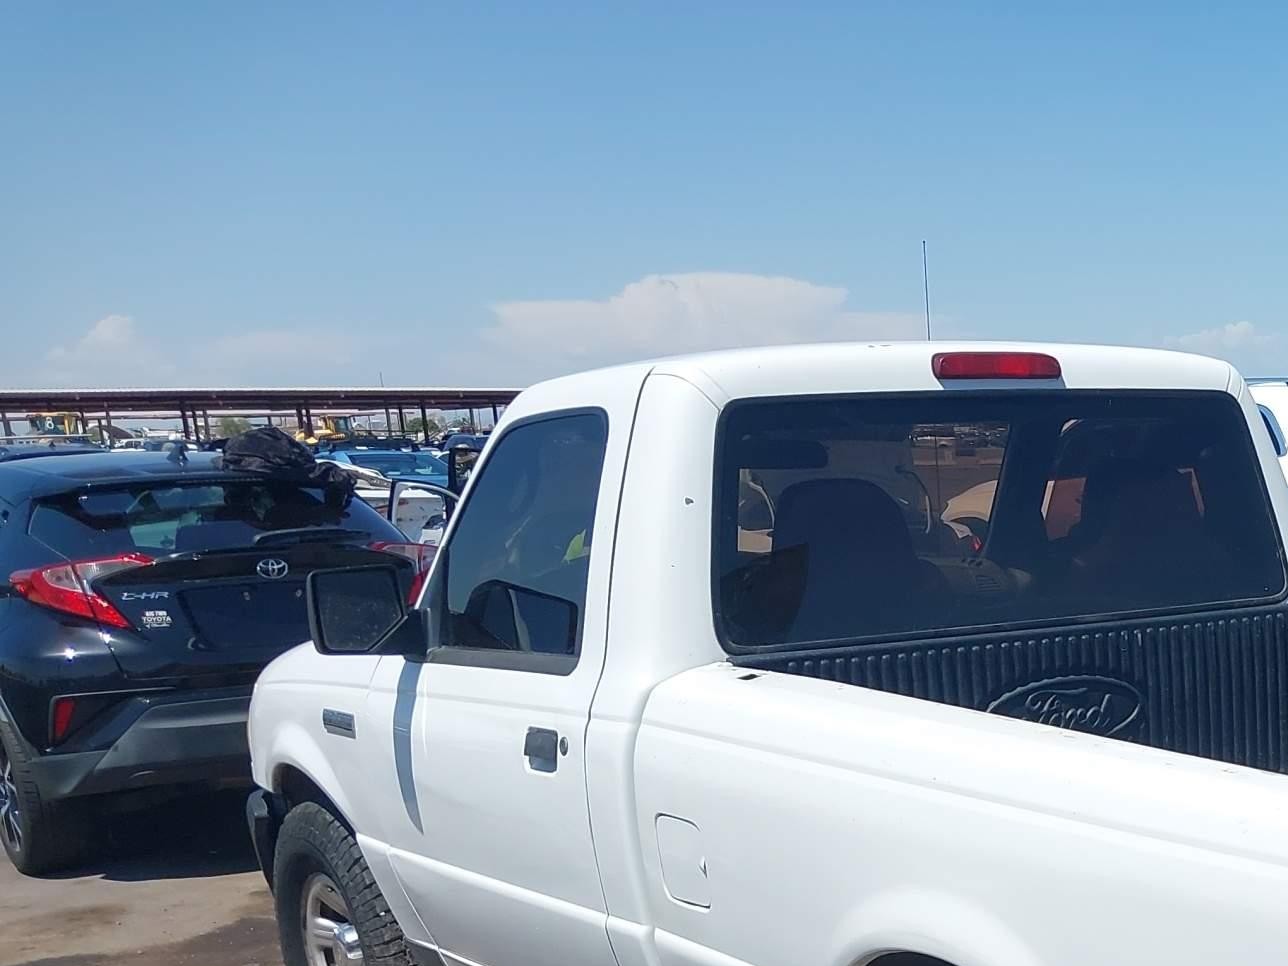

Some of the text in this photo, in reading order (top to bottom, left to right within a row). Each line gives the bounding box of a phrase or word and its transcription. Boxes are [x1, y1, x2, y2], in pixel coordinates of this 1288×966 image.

[121, 591, 169, 600] C-HR
[142, 616, 173, 624] TOYOTA
[1025, 686, 1111, 730] Ford
